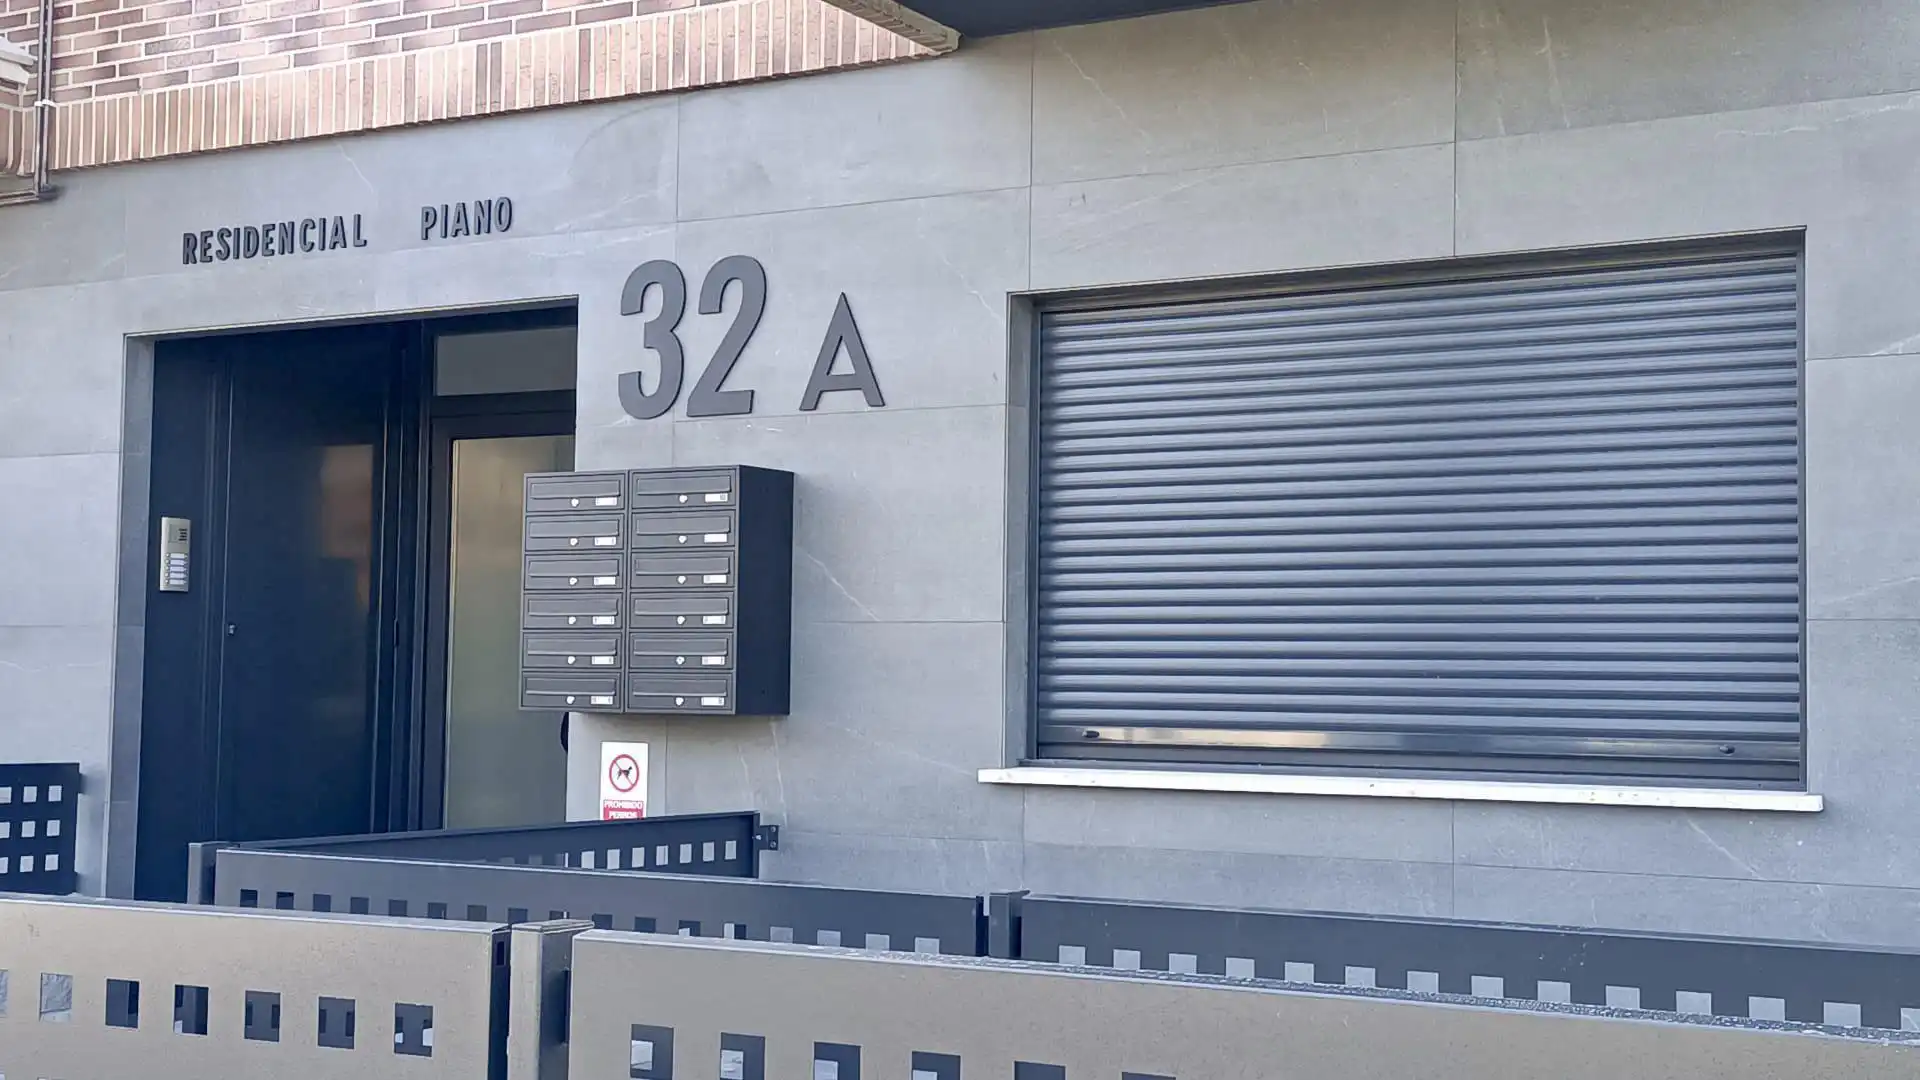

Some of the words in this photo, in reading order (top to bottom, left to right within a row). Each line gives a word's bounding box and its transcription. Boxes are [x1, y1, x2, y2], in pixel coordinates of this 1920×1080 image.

[183, 214, 367, 264] RESIDENCIAL
[421, 197, 512, 240] PIANO
[618, 255, 767, 420] 32
[799, 292, 886, 411] A
